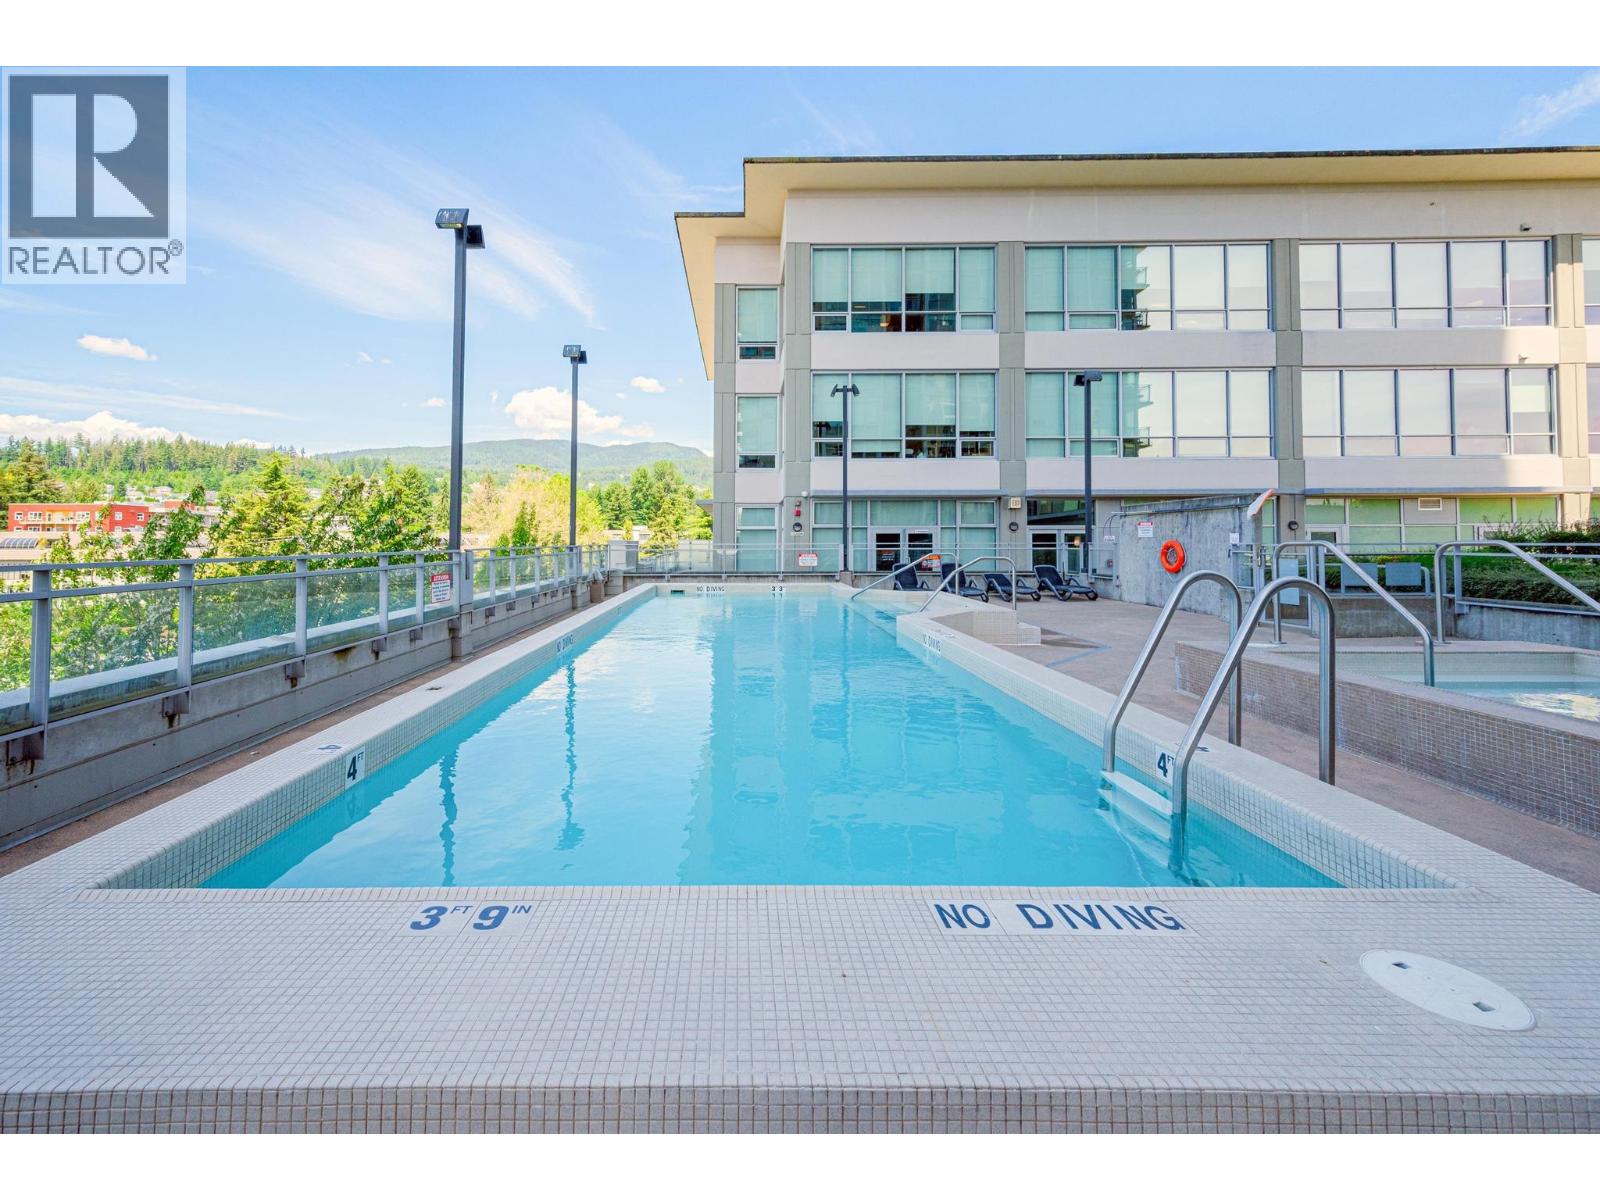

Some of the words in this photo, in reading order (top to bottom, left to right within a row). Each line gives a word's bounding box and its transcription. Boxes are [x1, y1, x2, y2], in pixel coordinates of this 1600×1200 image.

[347, 756, 357, 780] 4
[1158, 752, 1168, 777] 4
[934, 903, 991, 929] NO
[1015, 903, 1186, 931] DIVING
